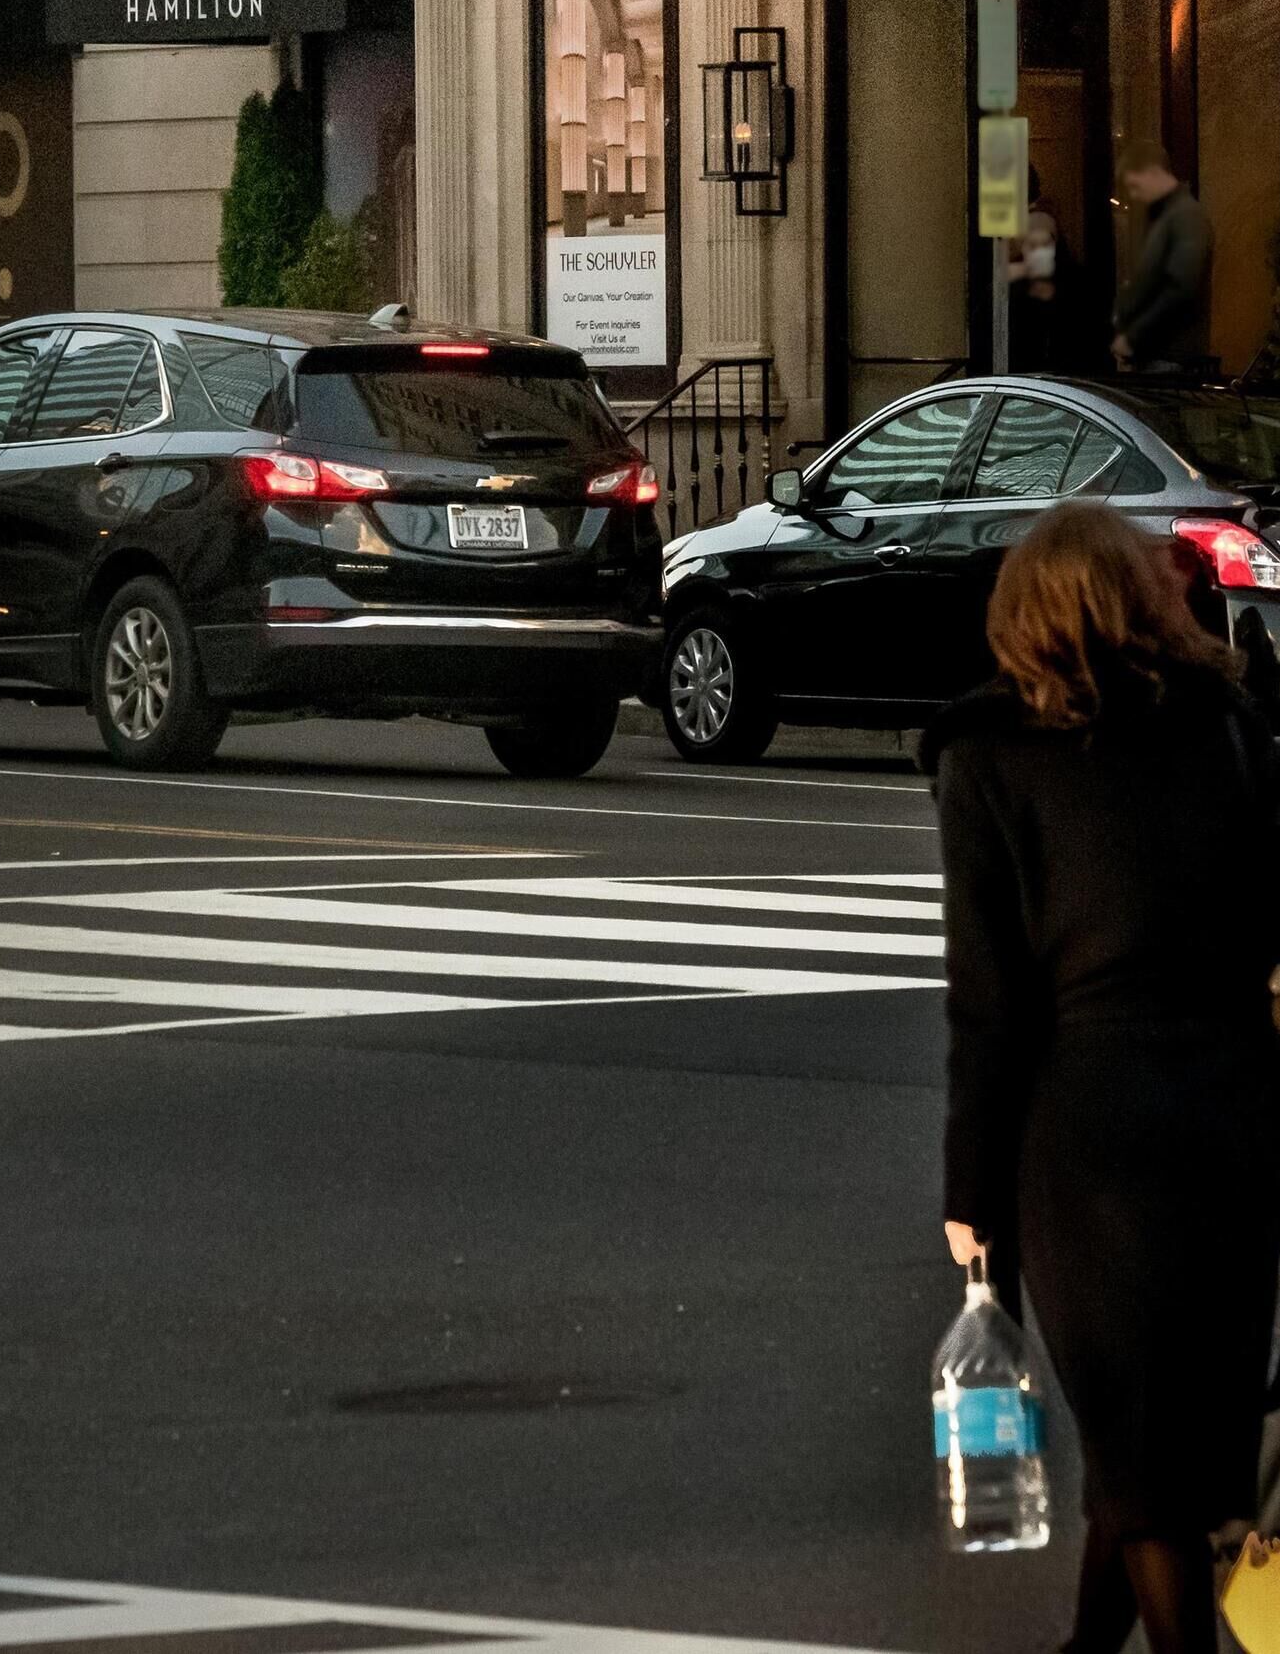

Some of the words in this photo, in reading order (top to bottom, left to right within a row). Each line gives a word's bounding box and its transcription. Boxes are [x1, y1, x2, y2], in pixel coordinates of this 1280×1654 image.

[560, 253, 582, 271] THE
[586, 251, 656, 271] SCHUYLER
[563, 293, 576, 302] Our
[606, 292, 622, 301] Your
[624, 291, 653, 301] Creation
[576, 321, 588, 330] For
[589, 320, 609, 329] Event
[591, 335, 606, 343] Visit
[608, 335, 617, 343] Us
[456, 517, 520, 537] UVK-2837
